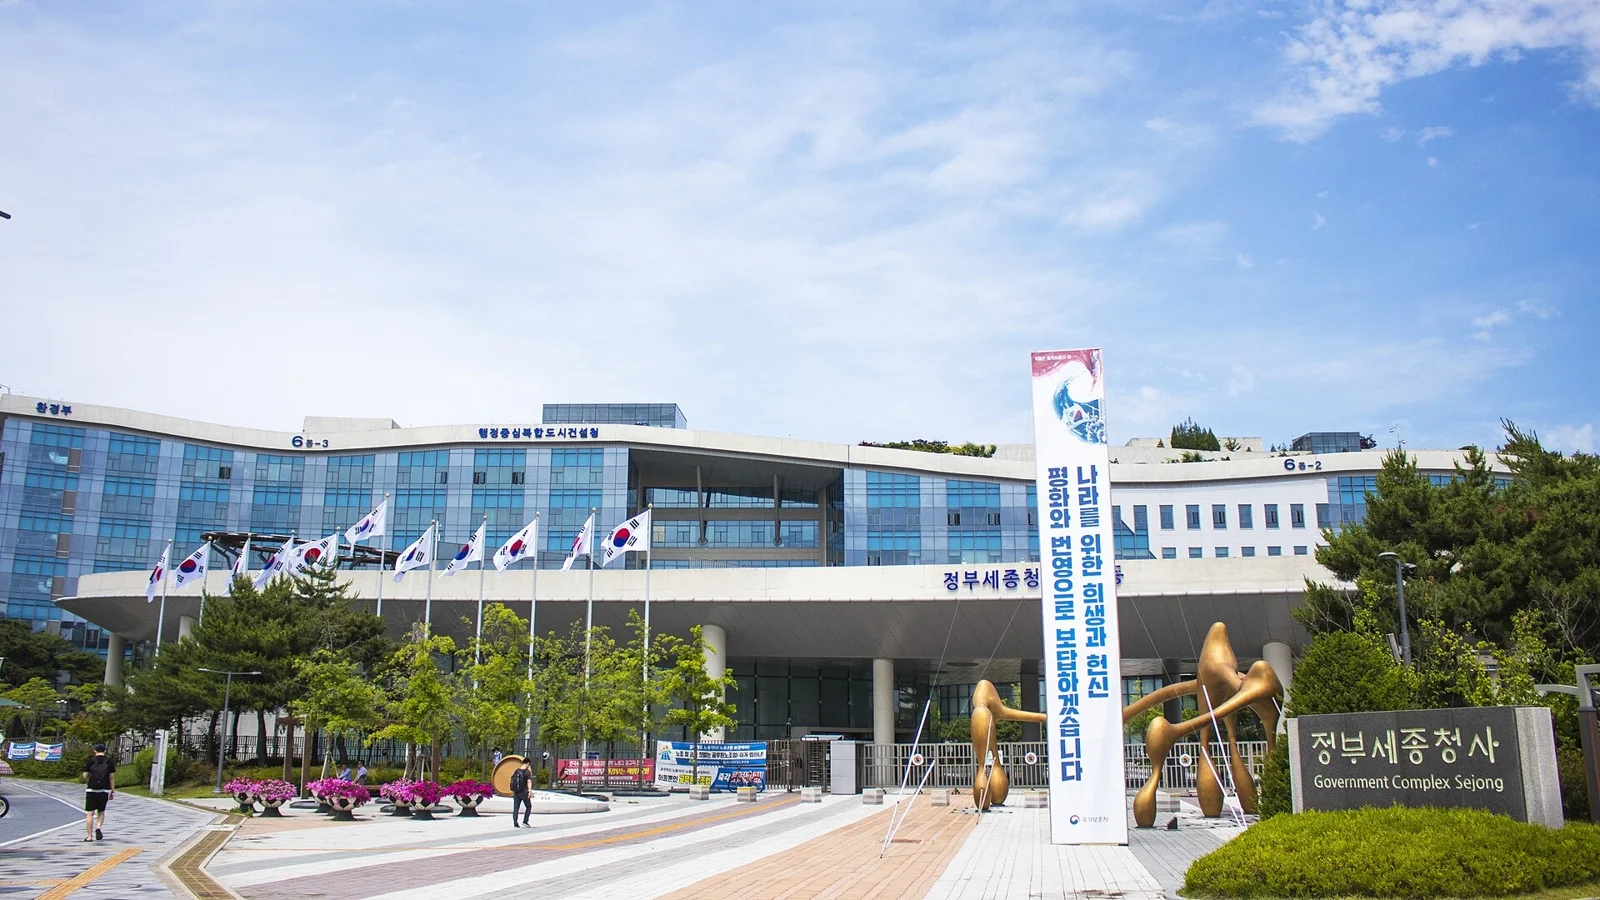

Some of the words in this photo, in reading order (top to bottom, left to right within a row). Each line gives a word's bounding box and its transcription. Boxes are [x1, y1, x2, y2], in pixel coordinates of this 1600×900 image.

[36, 402, 72, 415] 환경부
[478, 427, 599, 439] 행정중심복합도시건설청
[1048, 467, 1071, 529] 평화와
[1077, 465, 1099, 528] 나라를
[1081, 534, 1103, 577] 위한
[943, 568, 1039, 591] 정부세종청
[1051, 535, 1075, 621] 번영으로
[1083, 583, 1107, 647] 희생과
[1087, 654, 1109, 699] 헌신
[1056, 628, 1083, 782] 보답하겠습니다
[1311, 726, 1500, 765] 정부세종청사
[1314, 774, 1389, 789] Government
[1392, 775, 1451, 792] Complex
[1455, 774, 1504, 792] Sejong
